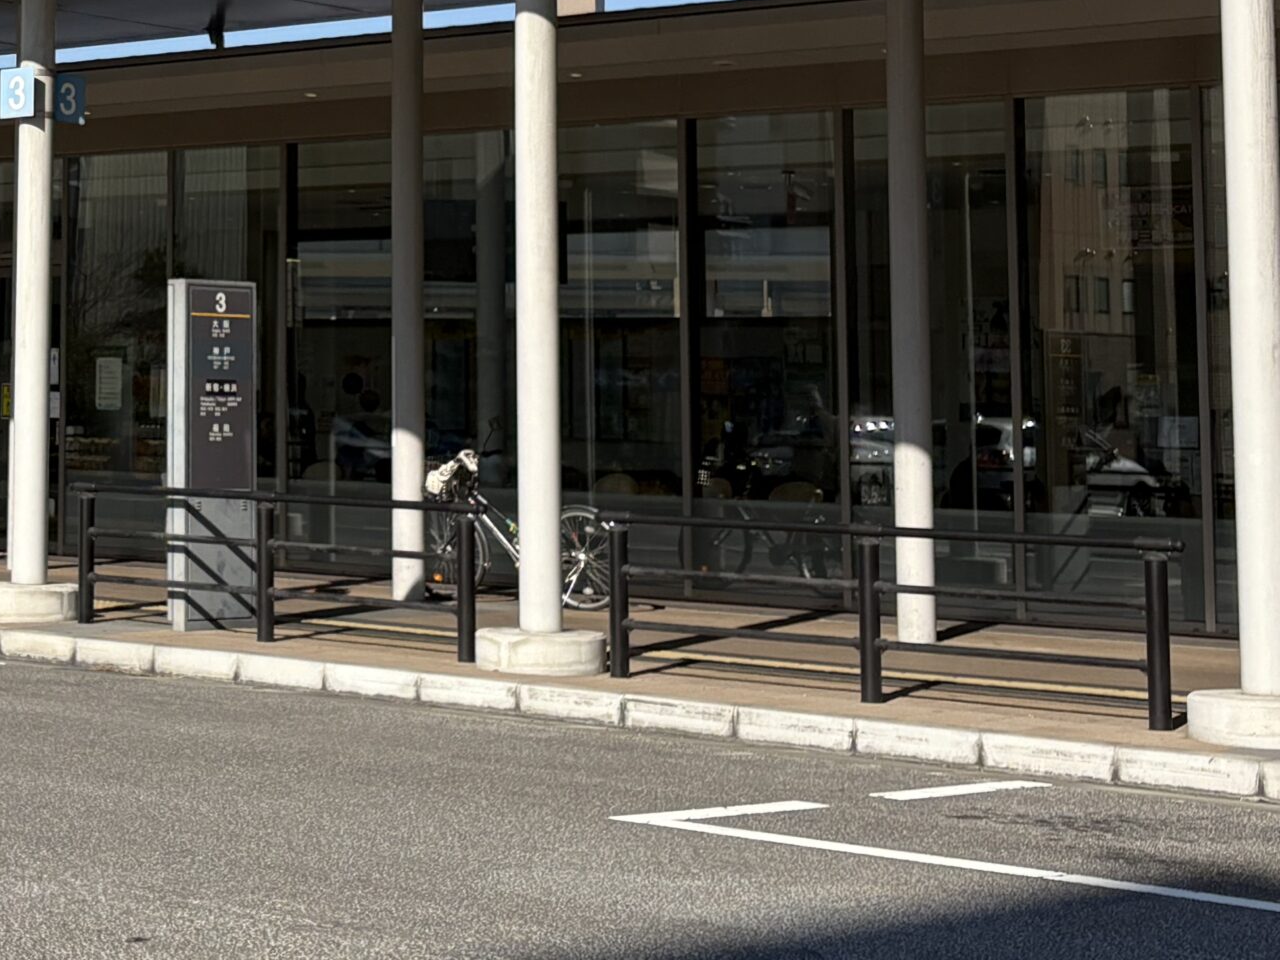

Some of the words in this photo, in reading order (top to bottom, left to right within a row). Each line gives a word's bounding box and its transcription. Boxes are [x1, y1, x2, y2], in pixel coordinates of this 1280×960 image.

[8, 75, 26, 111] 3
[60, 82, 76, 115] 3
[215, 292, 227, 313] 3
